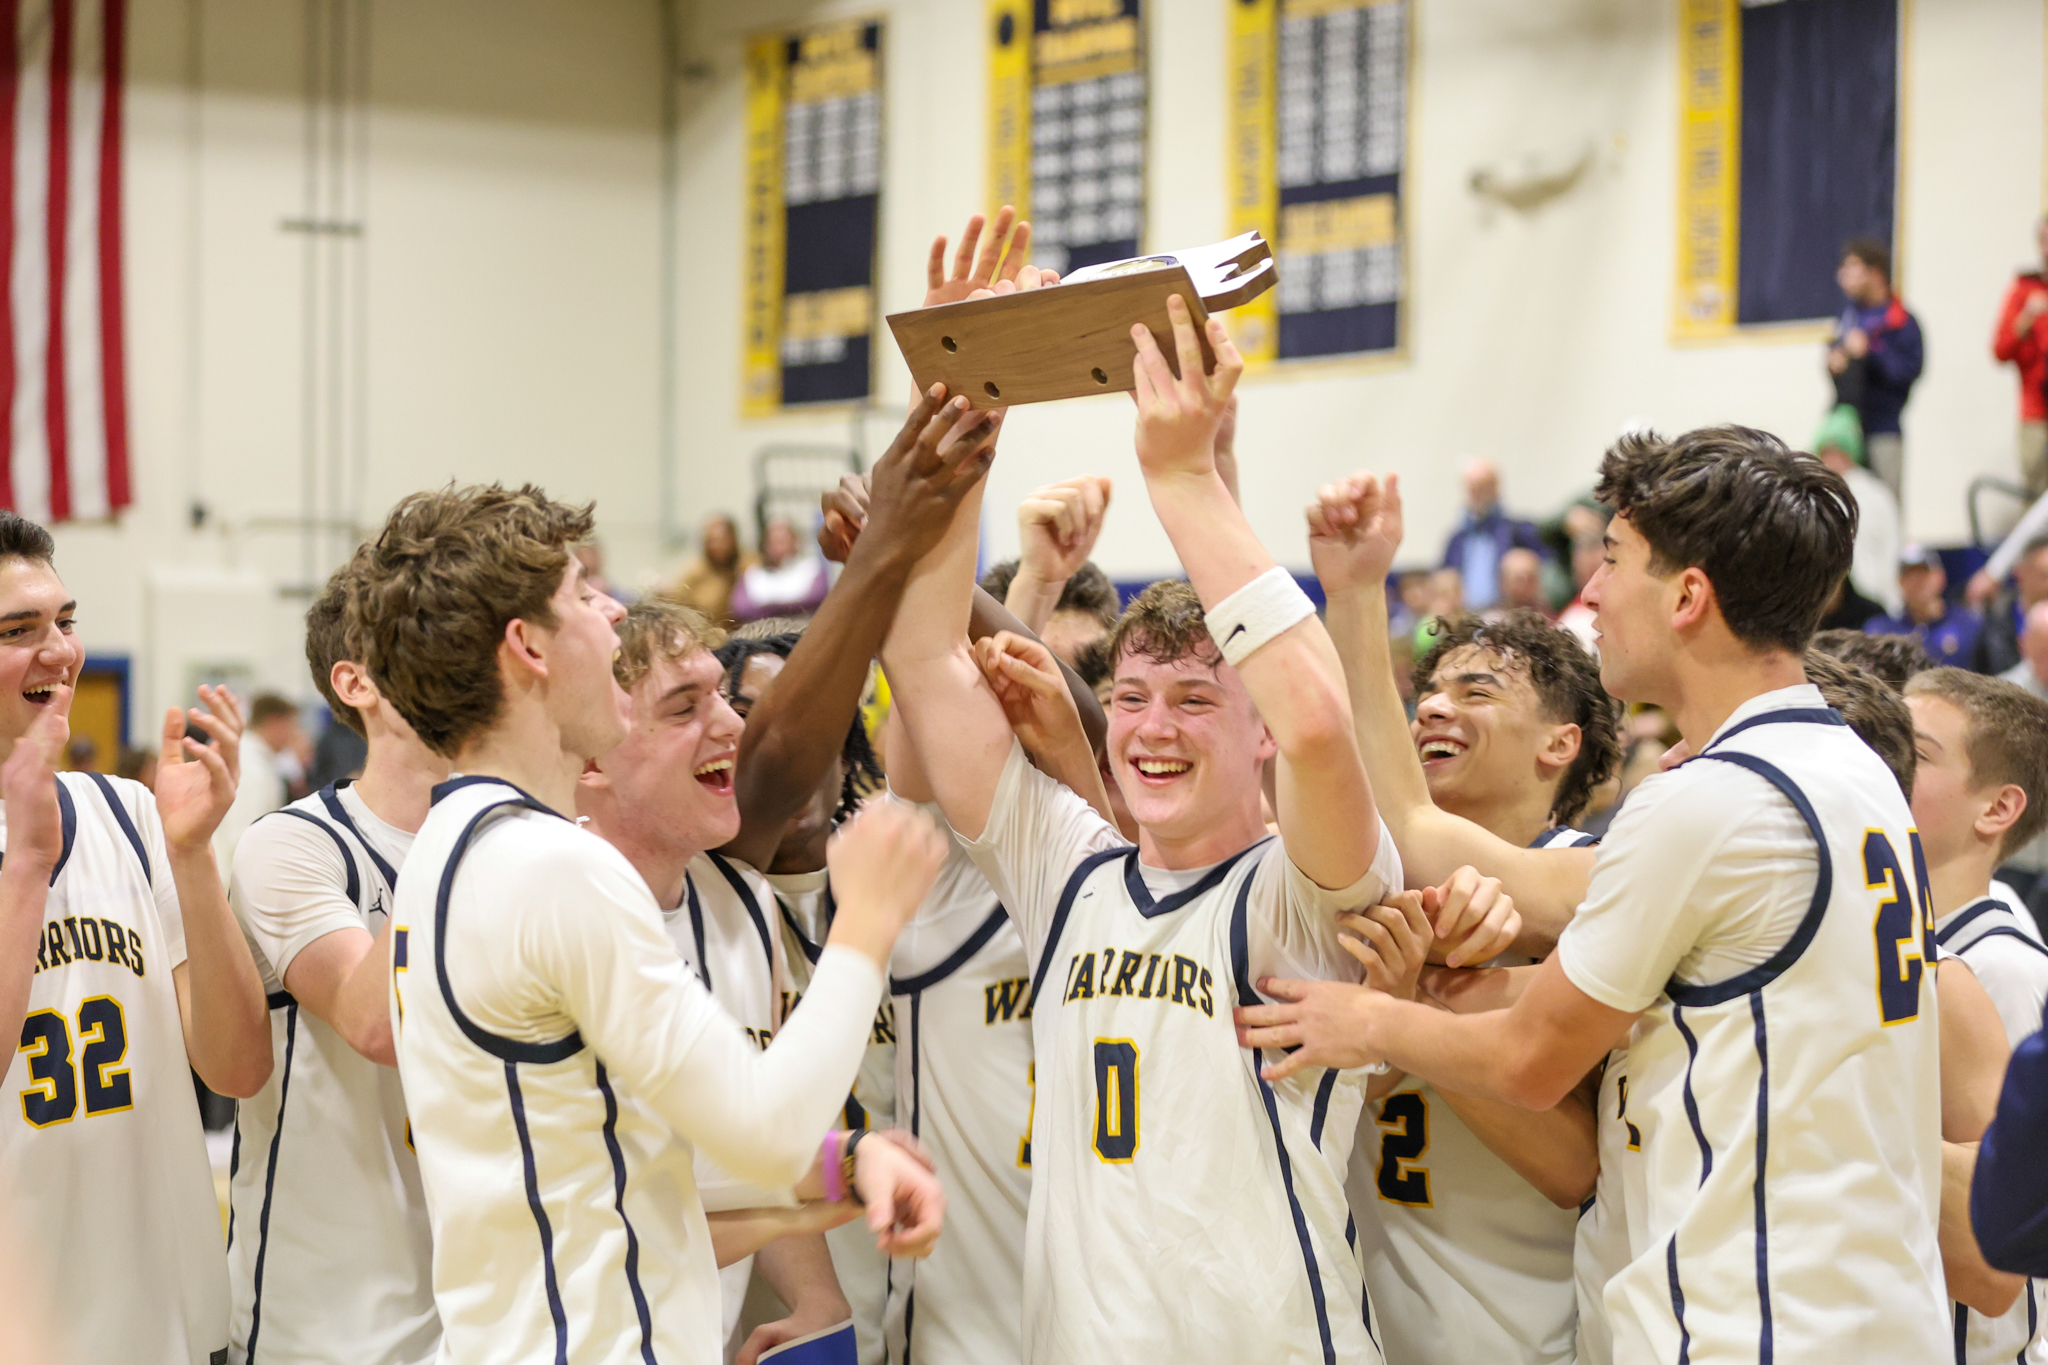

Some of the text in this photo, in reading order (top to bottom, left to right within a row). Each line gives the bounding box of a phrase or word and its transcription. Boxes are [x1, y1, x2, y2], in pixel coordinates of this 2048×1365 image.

[1062, 947, 1214, 1019] ARRIRS
[18, 993, 134, 1130] 32
[1091, 1036, 1141, 1164] 0
[1375, 1089, 1434, 1209] 2
